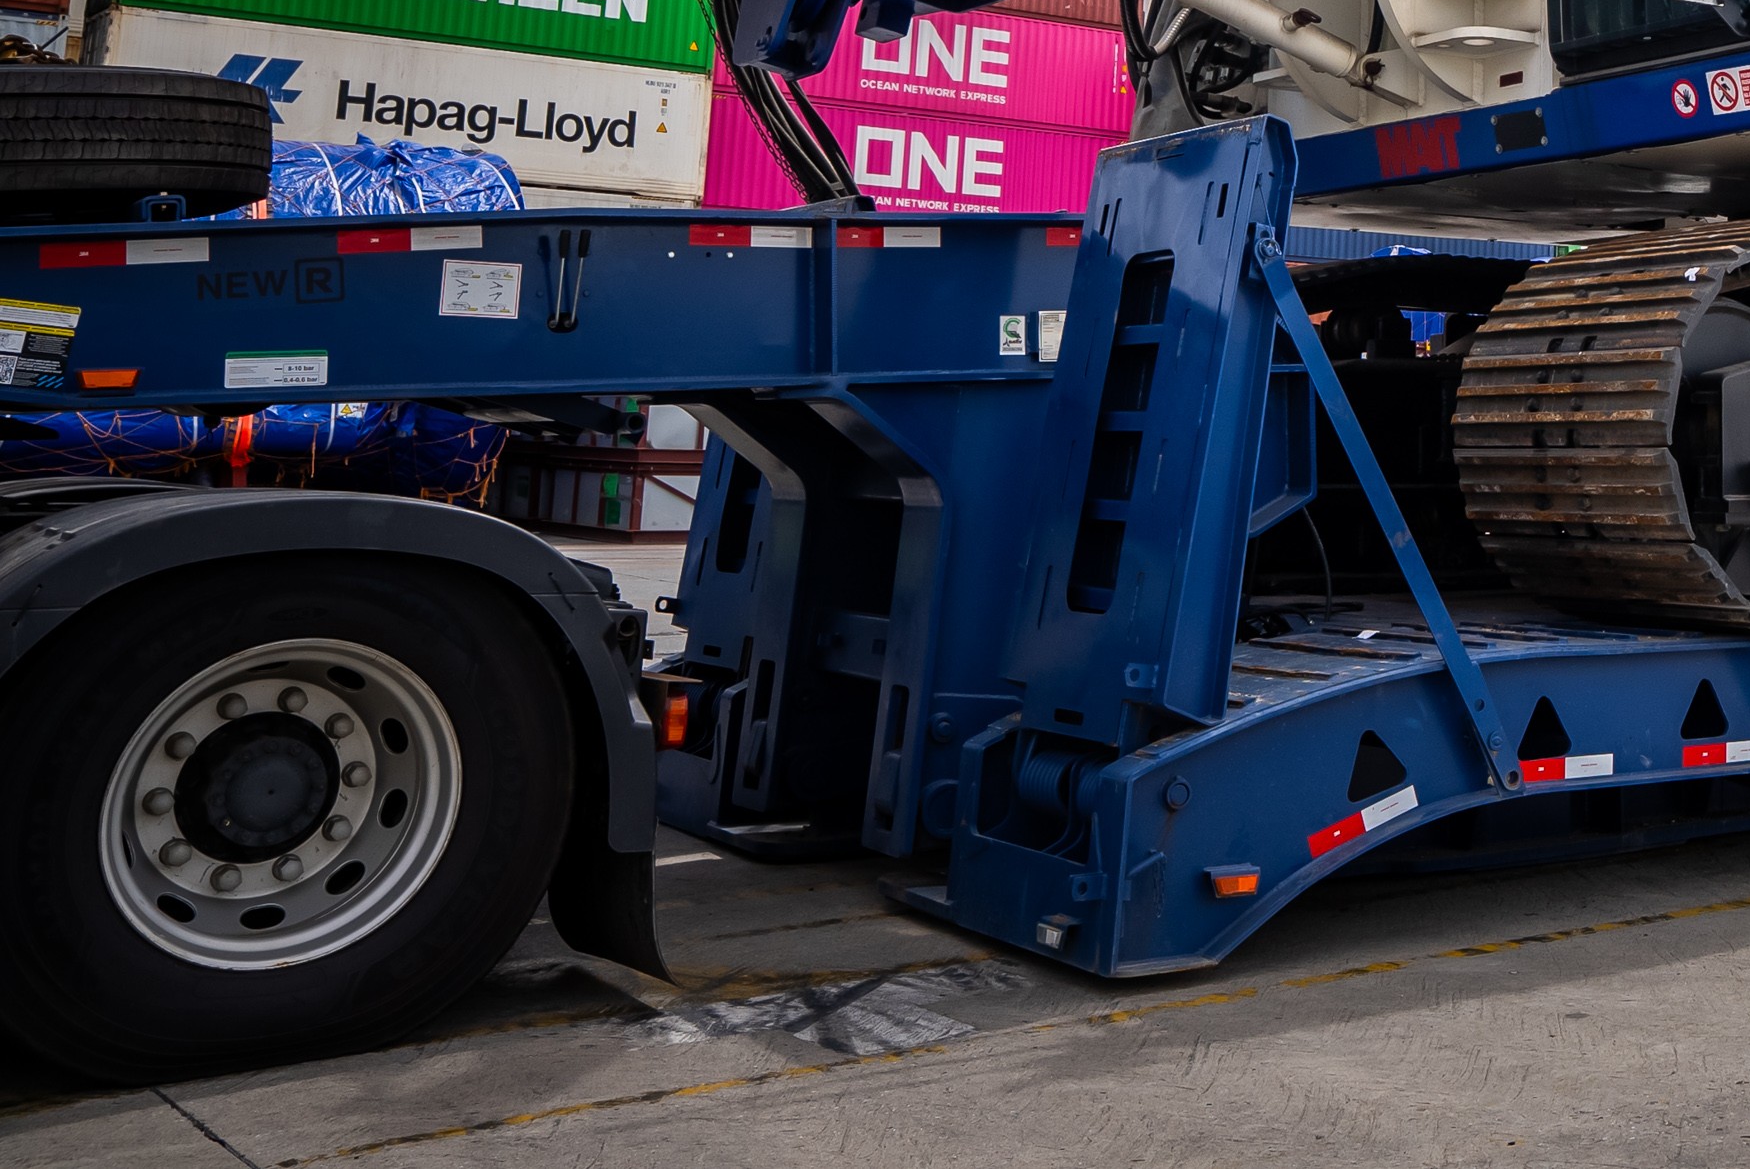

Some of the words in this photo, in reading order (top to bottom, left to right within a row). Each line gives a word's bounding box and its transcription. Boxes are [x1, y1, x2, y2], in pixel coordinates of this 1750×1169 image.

[861, 18, 1011, 89] ONE
[335, 79, 637, 154] Hapag-Lloyd
[860, 78, 900, 92] OCEAN
[903, 83, 956, 99] NETWORK
[960, 90, 1007, 105] EXPRESS
[854, 124, 1004, 198] ONE
[1375, 115, 1462, 180] MAIT
[895, 197, 949, 211] NETWORK
[953, 203, 1000, 213] EXPRESS
[196, 269, 289, 301] NEW
